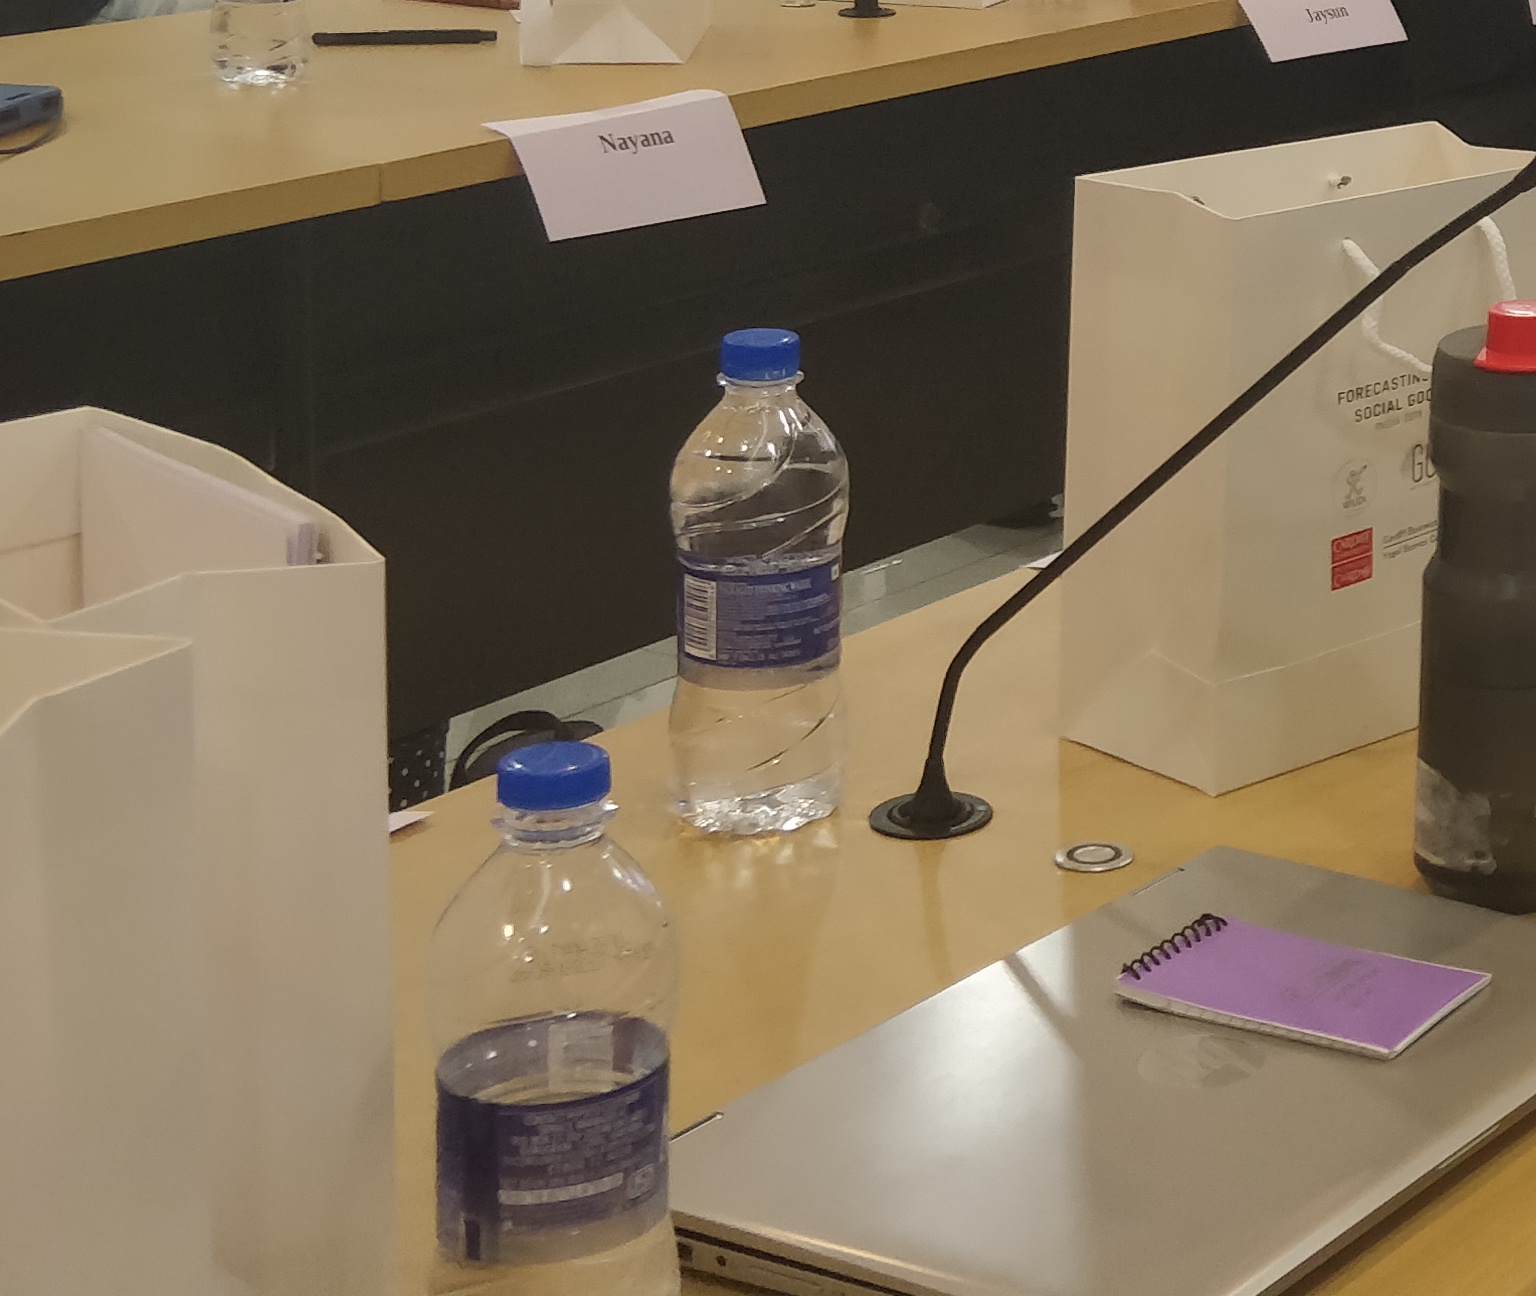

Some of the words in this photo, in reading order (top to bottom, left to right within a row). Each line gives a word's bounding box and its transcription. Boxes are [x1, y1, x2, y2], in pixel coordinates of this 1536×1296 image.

[597, 130, 676, 155] Nayana
[1337, 373, 1430, 406] FORECASTIN
[1354, 397, 1404, 423] SOCIAL
[1407, 388, 1433, 407] GOO
